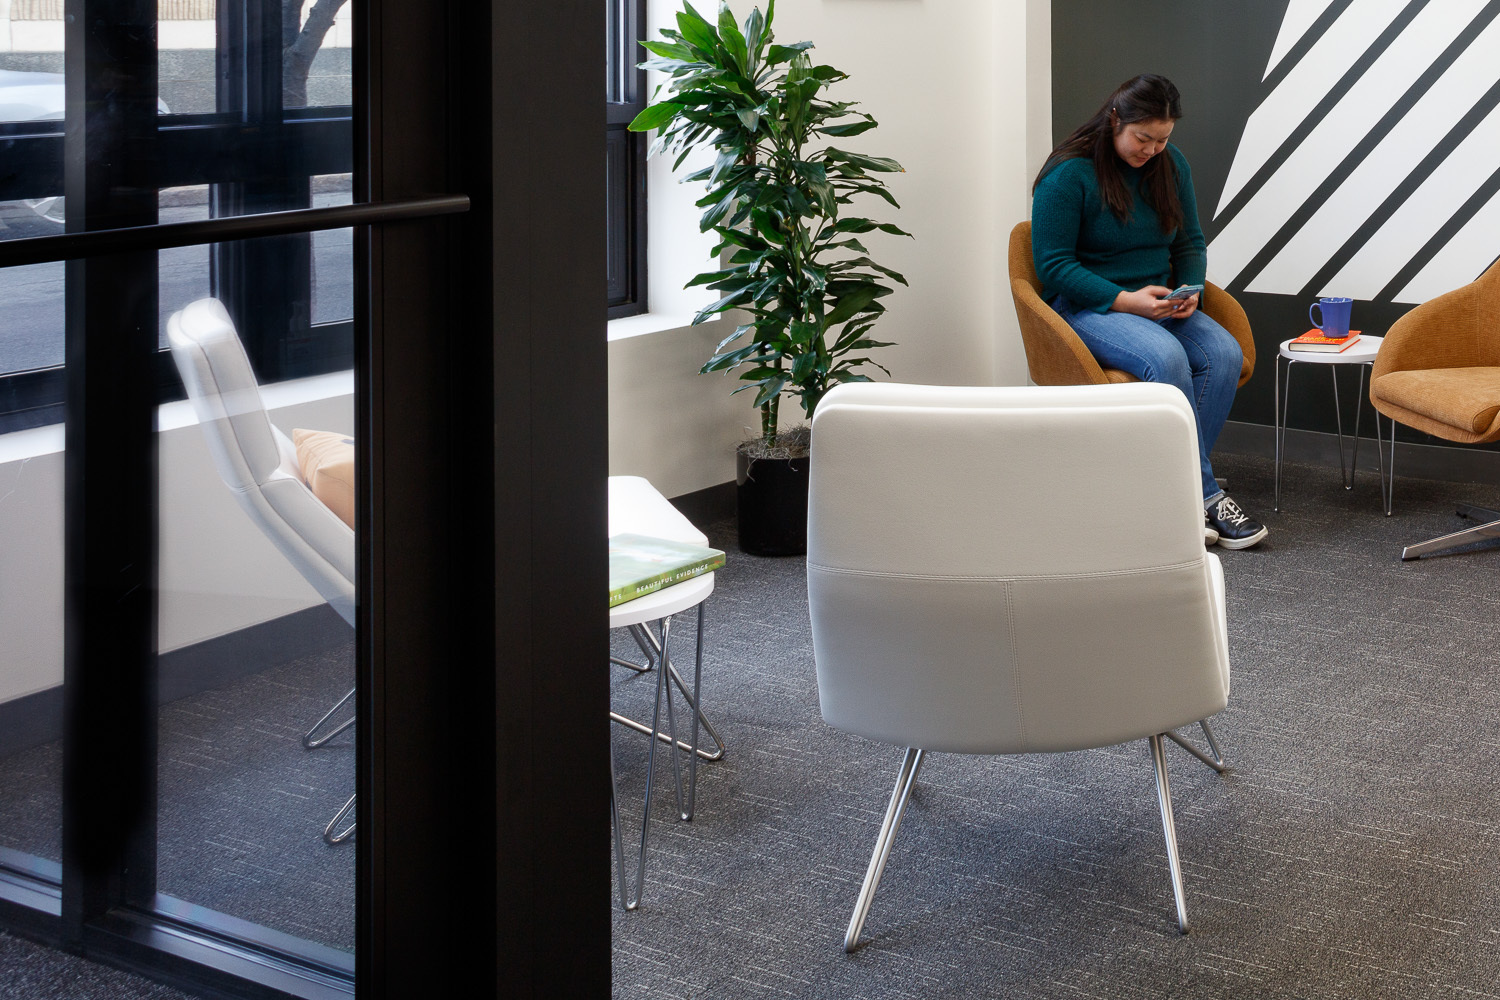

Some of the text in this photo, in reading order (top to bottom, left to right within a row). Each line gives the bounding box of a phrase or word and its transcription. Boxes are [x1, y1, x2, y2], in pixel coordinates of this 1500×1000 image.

[609, 564, 708, 602] FTE BEAUTIFUL EVIDENCE
